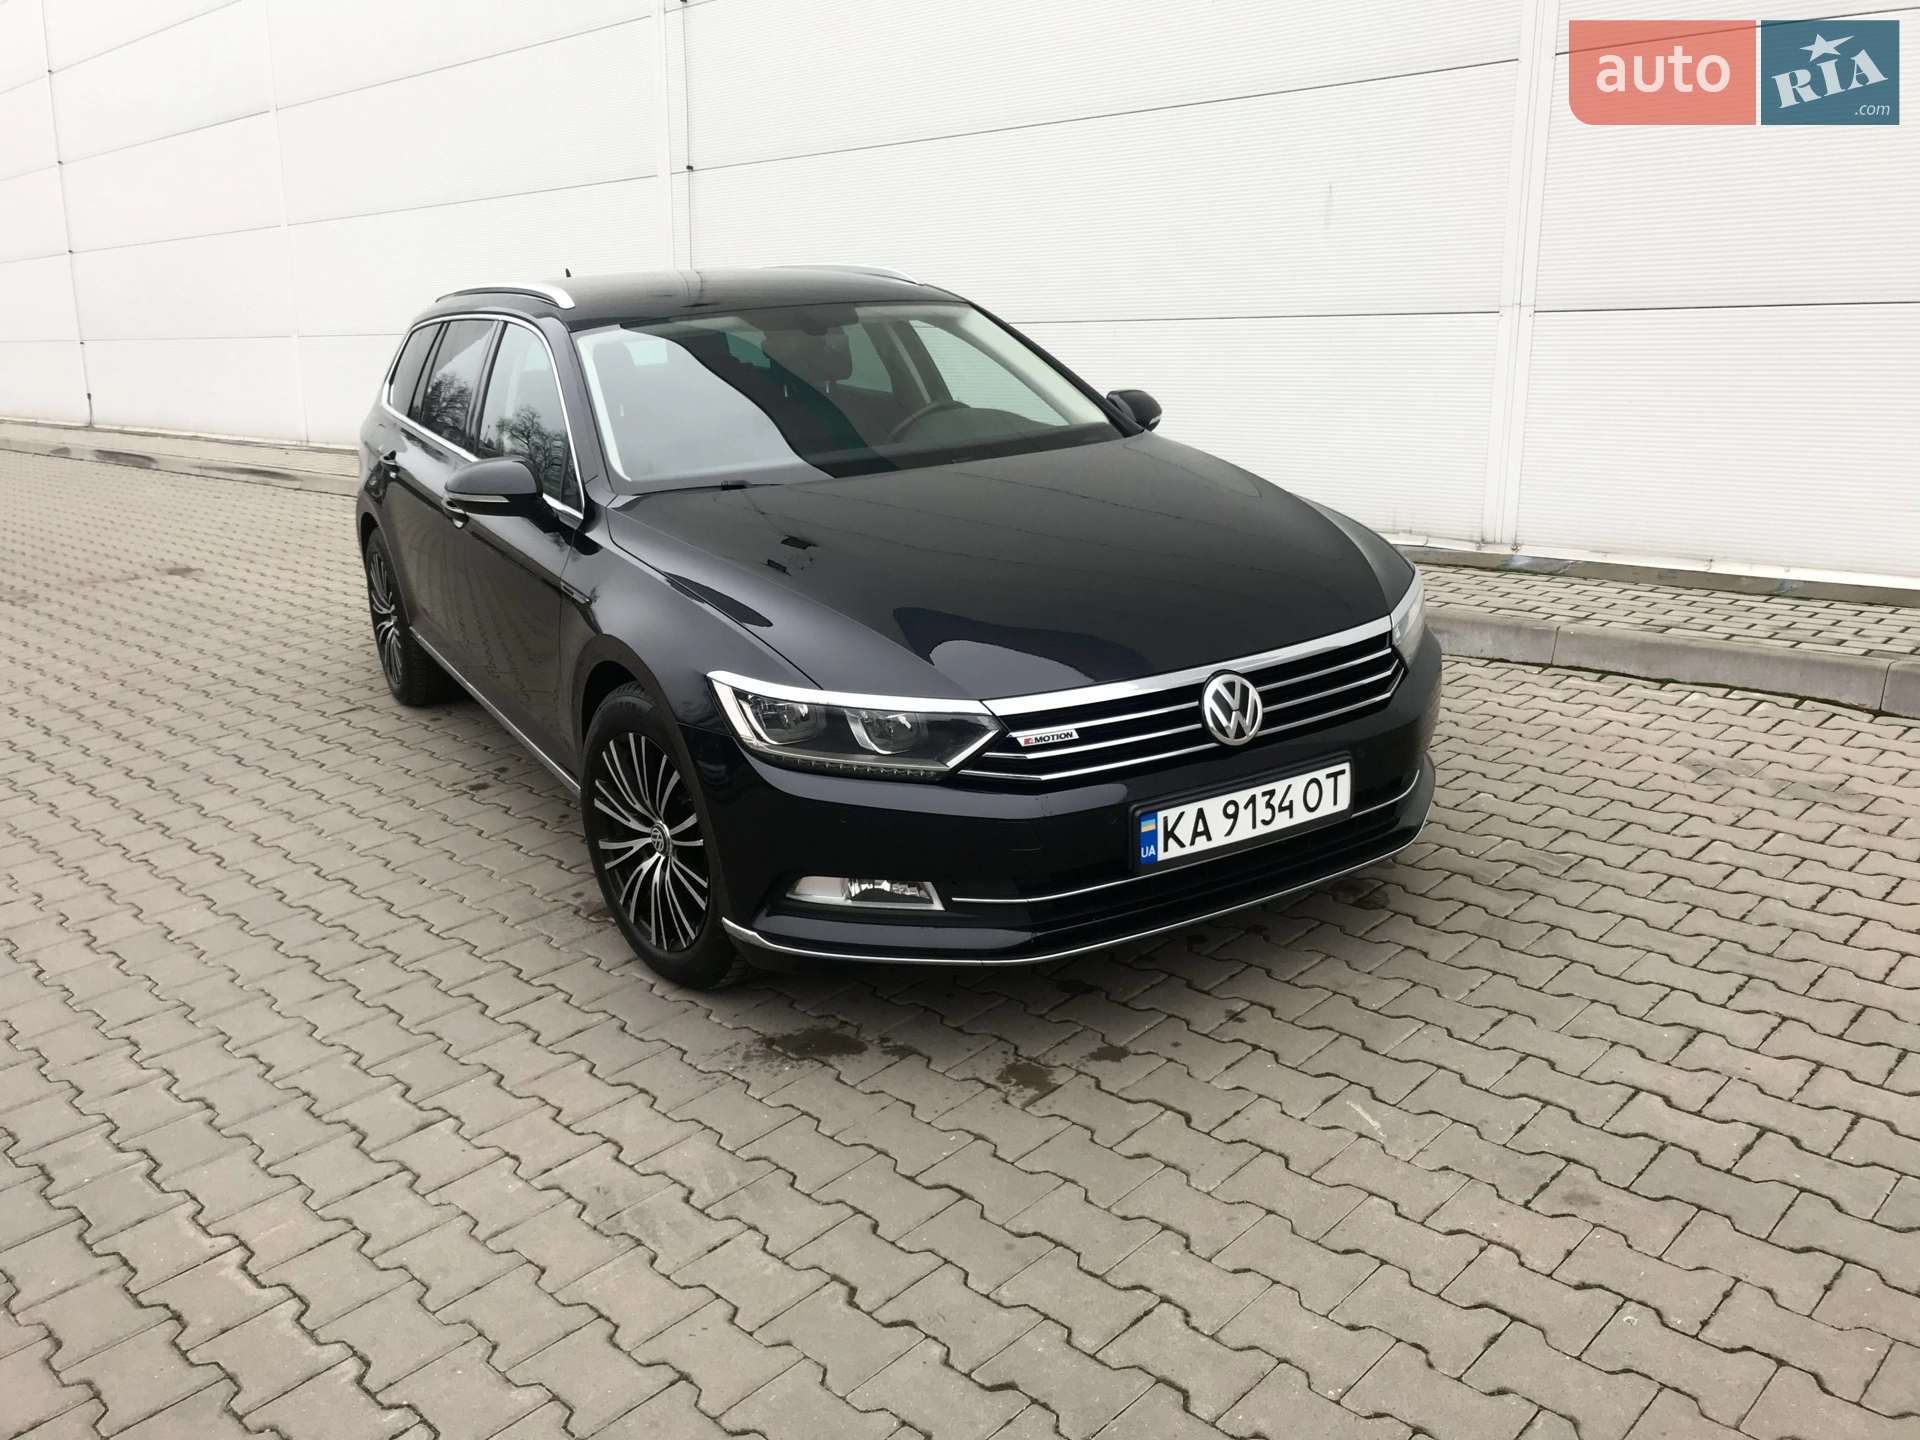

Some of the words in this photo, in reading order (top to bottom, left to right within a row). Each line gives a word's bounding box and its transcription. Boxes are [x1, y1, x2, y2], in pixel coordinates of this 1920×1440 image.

[1162, 807, 1212, 853] KA
[1222, 784, 1294, 837] 9134
[1302, 769, 1346, 813] OT
[1141, 846, 1156, 858] UA
